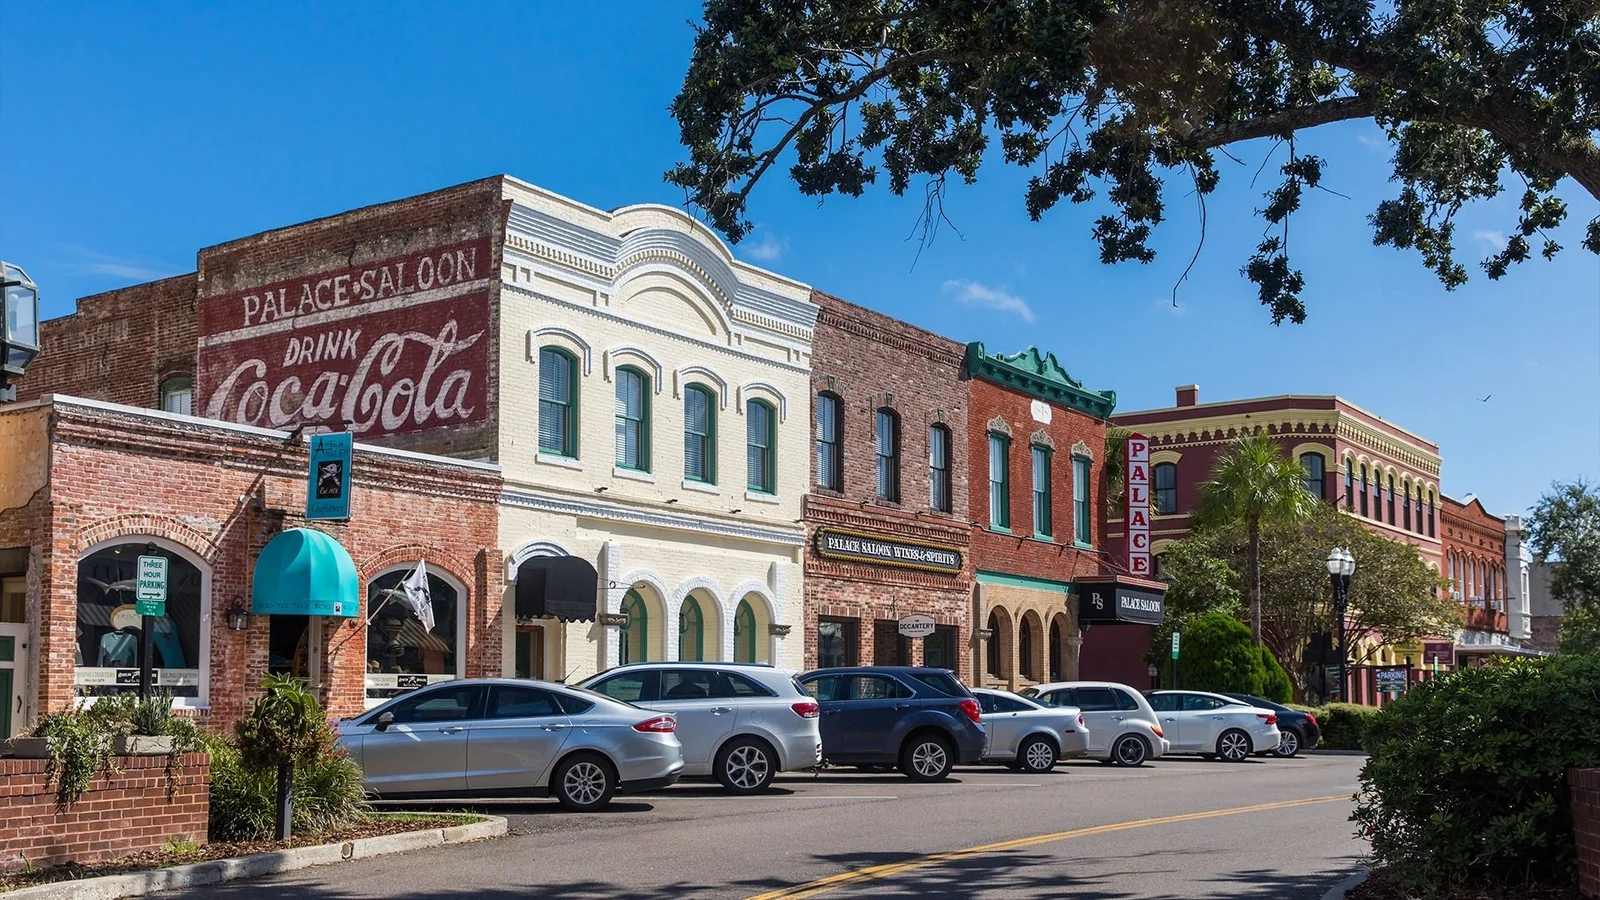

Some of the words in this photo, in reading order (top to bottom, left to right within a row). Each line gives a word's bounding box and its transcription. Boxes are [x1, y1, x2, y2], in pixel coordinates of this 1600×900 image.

[243, 274, 350, 327] PALACE
[360, 247, 477, 300] SALOON
[282, 328, 364, 368] DRINK
[205, 318, 486, 434] Coca-Cola
[1131, 442, 1148, 572] PALACE
[143, 560, 163, 569] THREE
[827, 537, 860, 552] PALACE
[861, 542, 892, 557] SALOON
[893, 546, 919, 560] WINES
[926, 551, 955, 565] SPIRITS
[139, 580, 165, 589] PARKING
[1121, 596, 1141, 610] PALACE
[1140, 599, 1161, 612] SALOON
[1380, 670, 1406, 680] PARKING
